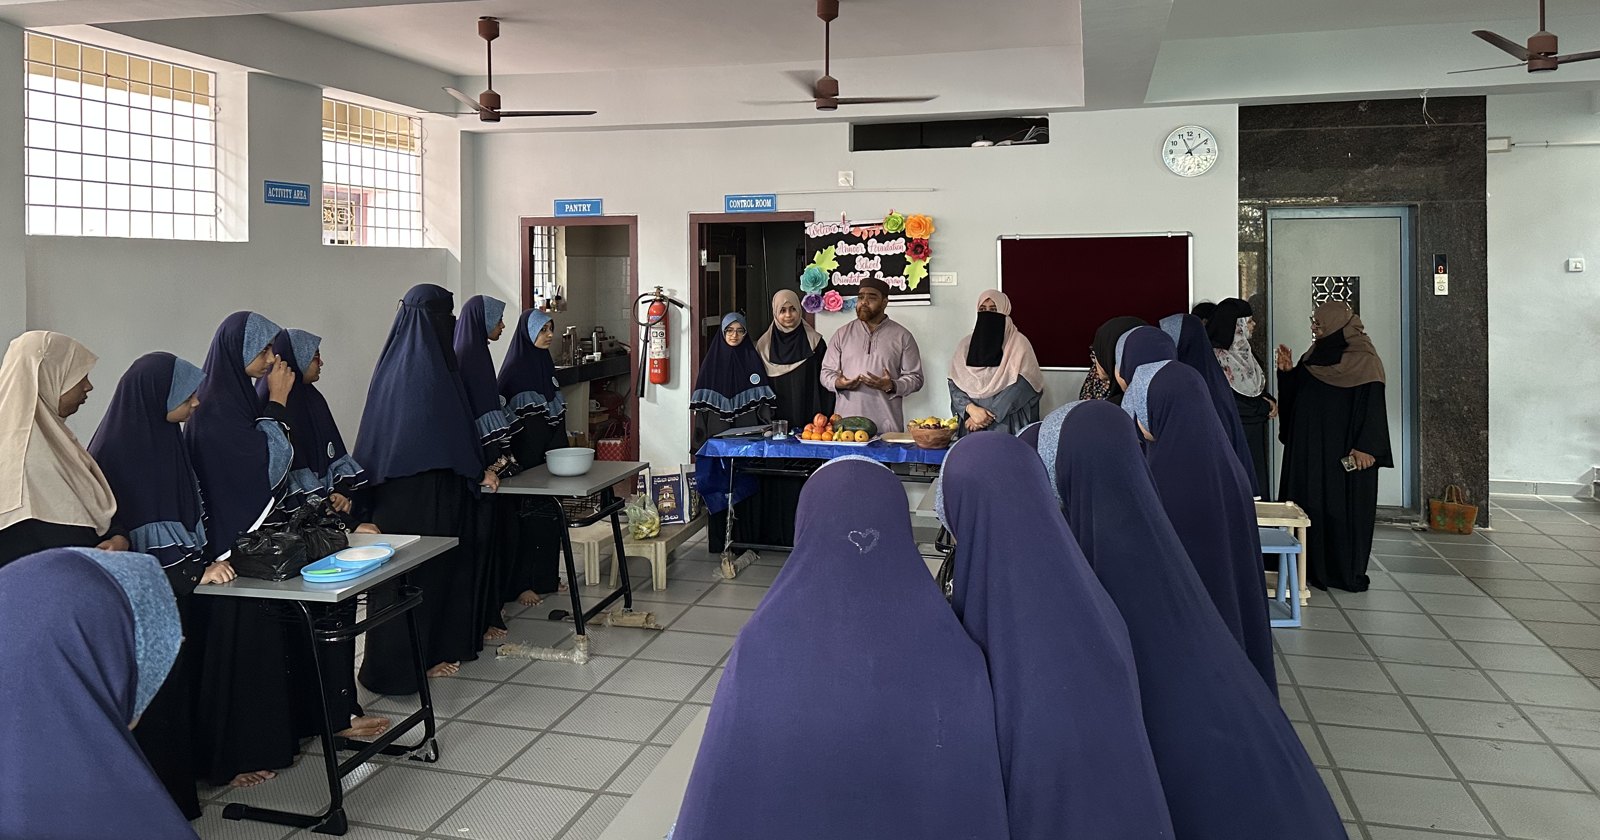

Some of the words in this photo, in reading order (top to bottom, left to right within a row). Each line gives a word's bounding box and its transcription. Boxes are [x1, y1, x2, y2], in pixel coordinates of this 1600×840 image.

[268, 187, 292, 199] ACTIVITY
[293, 190, 307, 200] AREA
[564, 203, 592, 213] PANTRY
[729, 199, 755, 209] CONTROL
[755, 198, 772, 208] ROOM
[806, 222, 839, 239] Welcome
[867, 238, 907, 255] Foundation
[855, 256, 881, 271] School
[1438, 265, 1444, 274] 0
